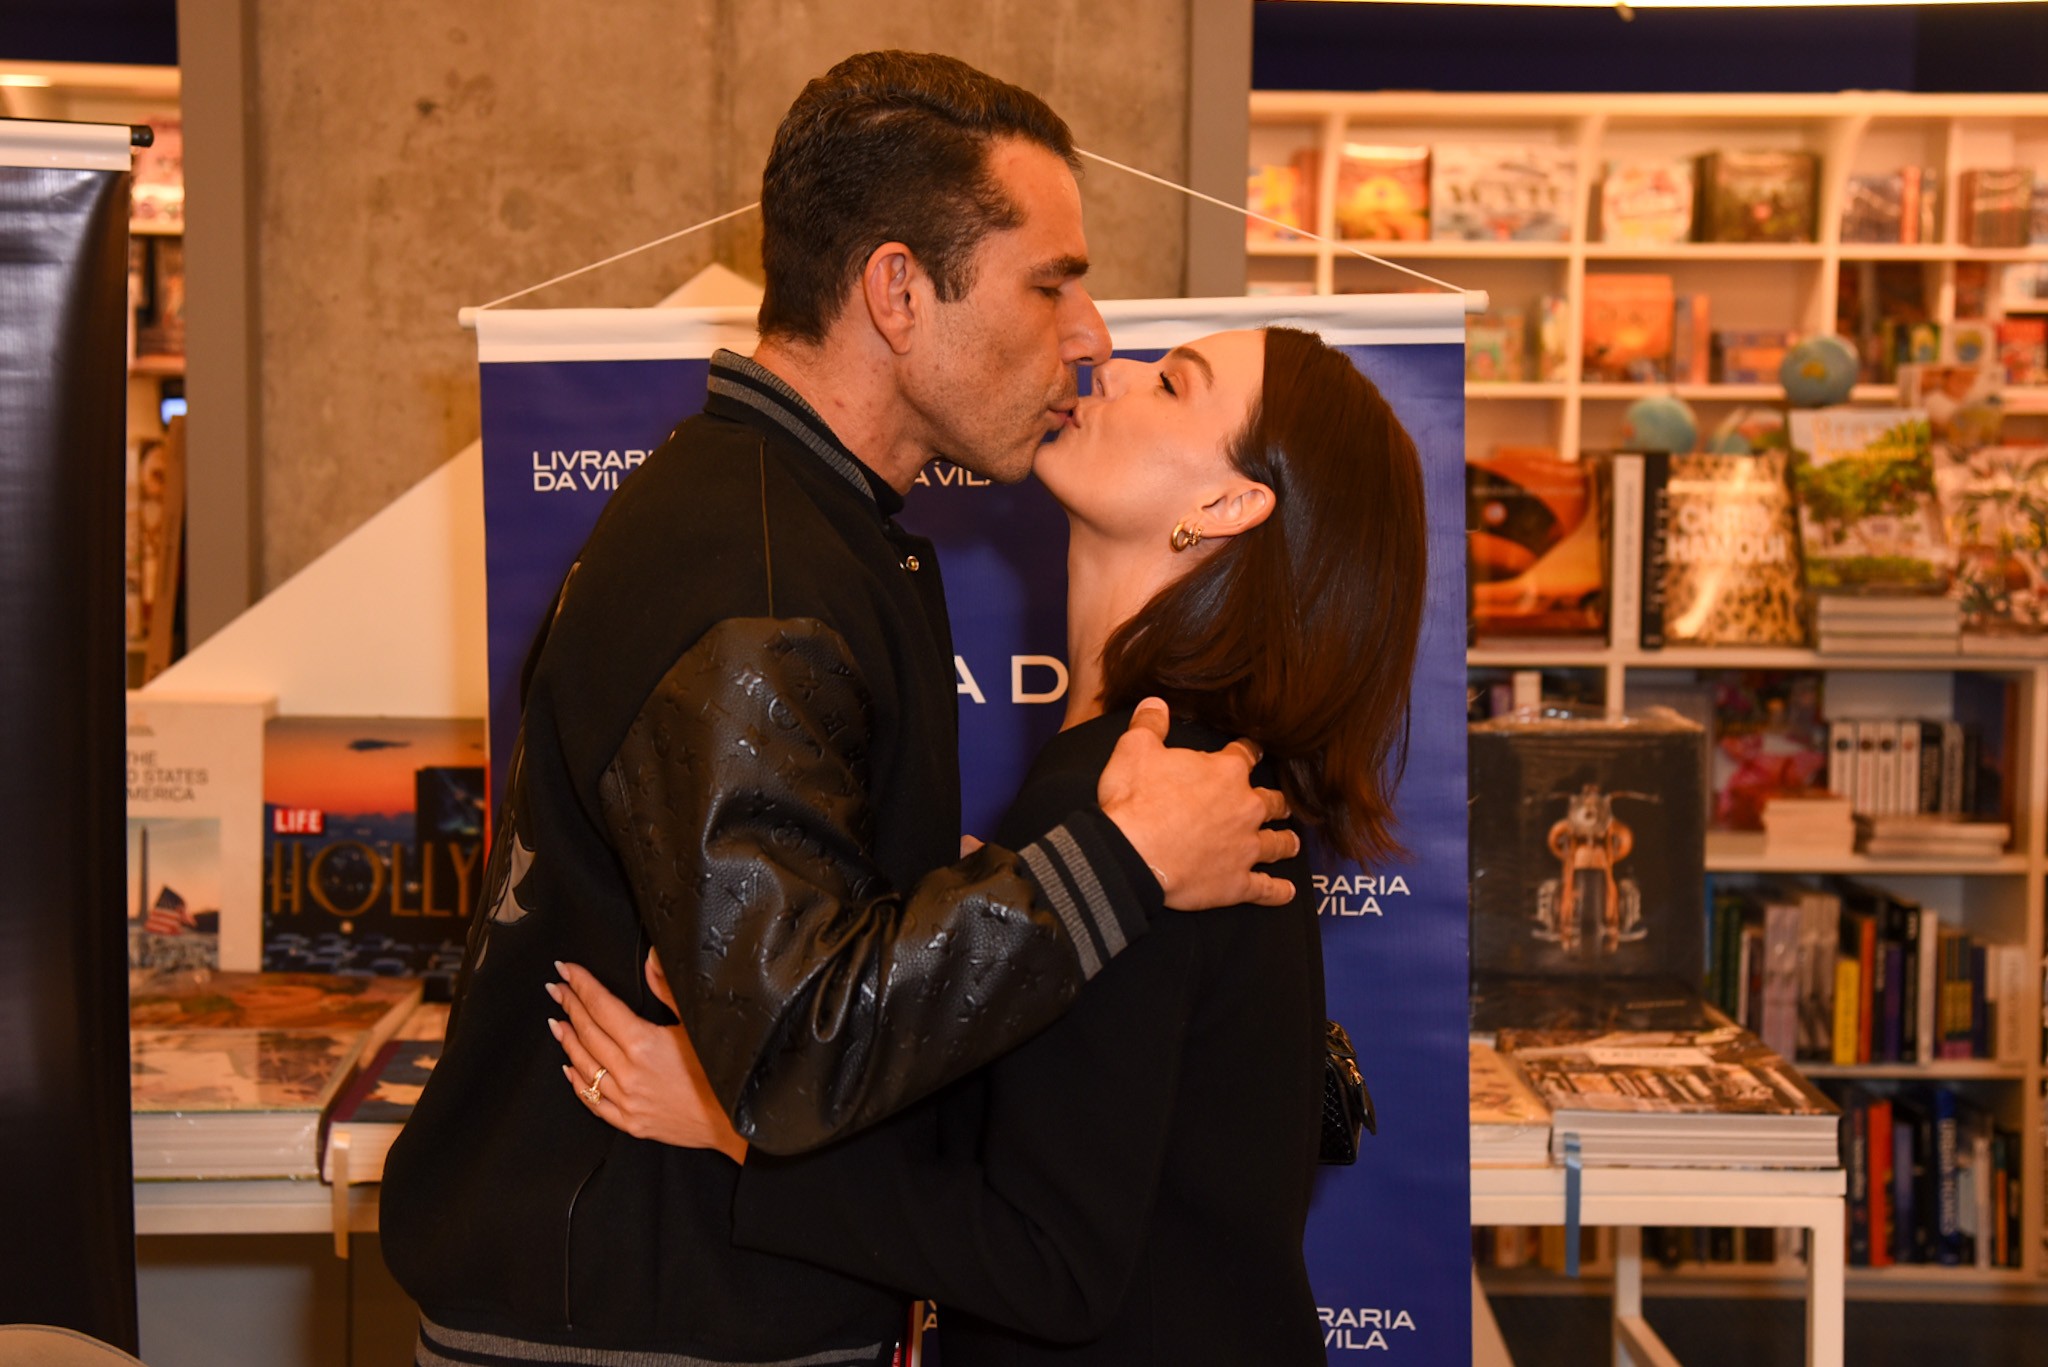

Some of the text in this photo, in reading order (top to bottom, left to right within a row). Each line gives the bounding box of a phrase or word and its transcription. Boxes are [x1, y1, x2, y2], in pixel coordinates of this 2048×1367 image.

[532, 450, 654, 471] LIVRAR
[533, 471, 578, 491] DA
[934, 466, 991, 487] VIL
[142, 767, 209, 786] STATES
[274, 809, 322, 833] LIFE
[271, 841, 481, 917] HOLLY
